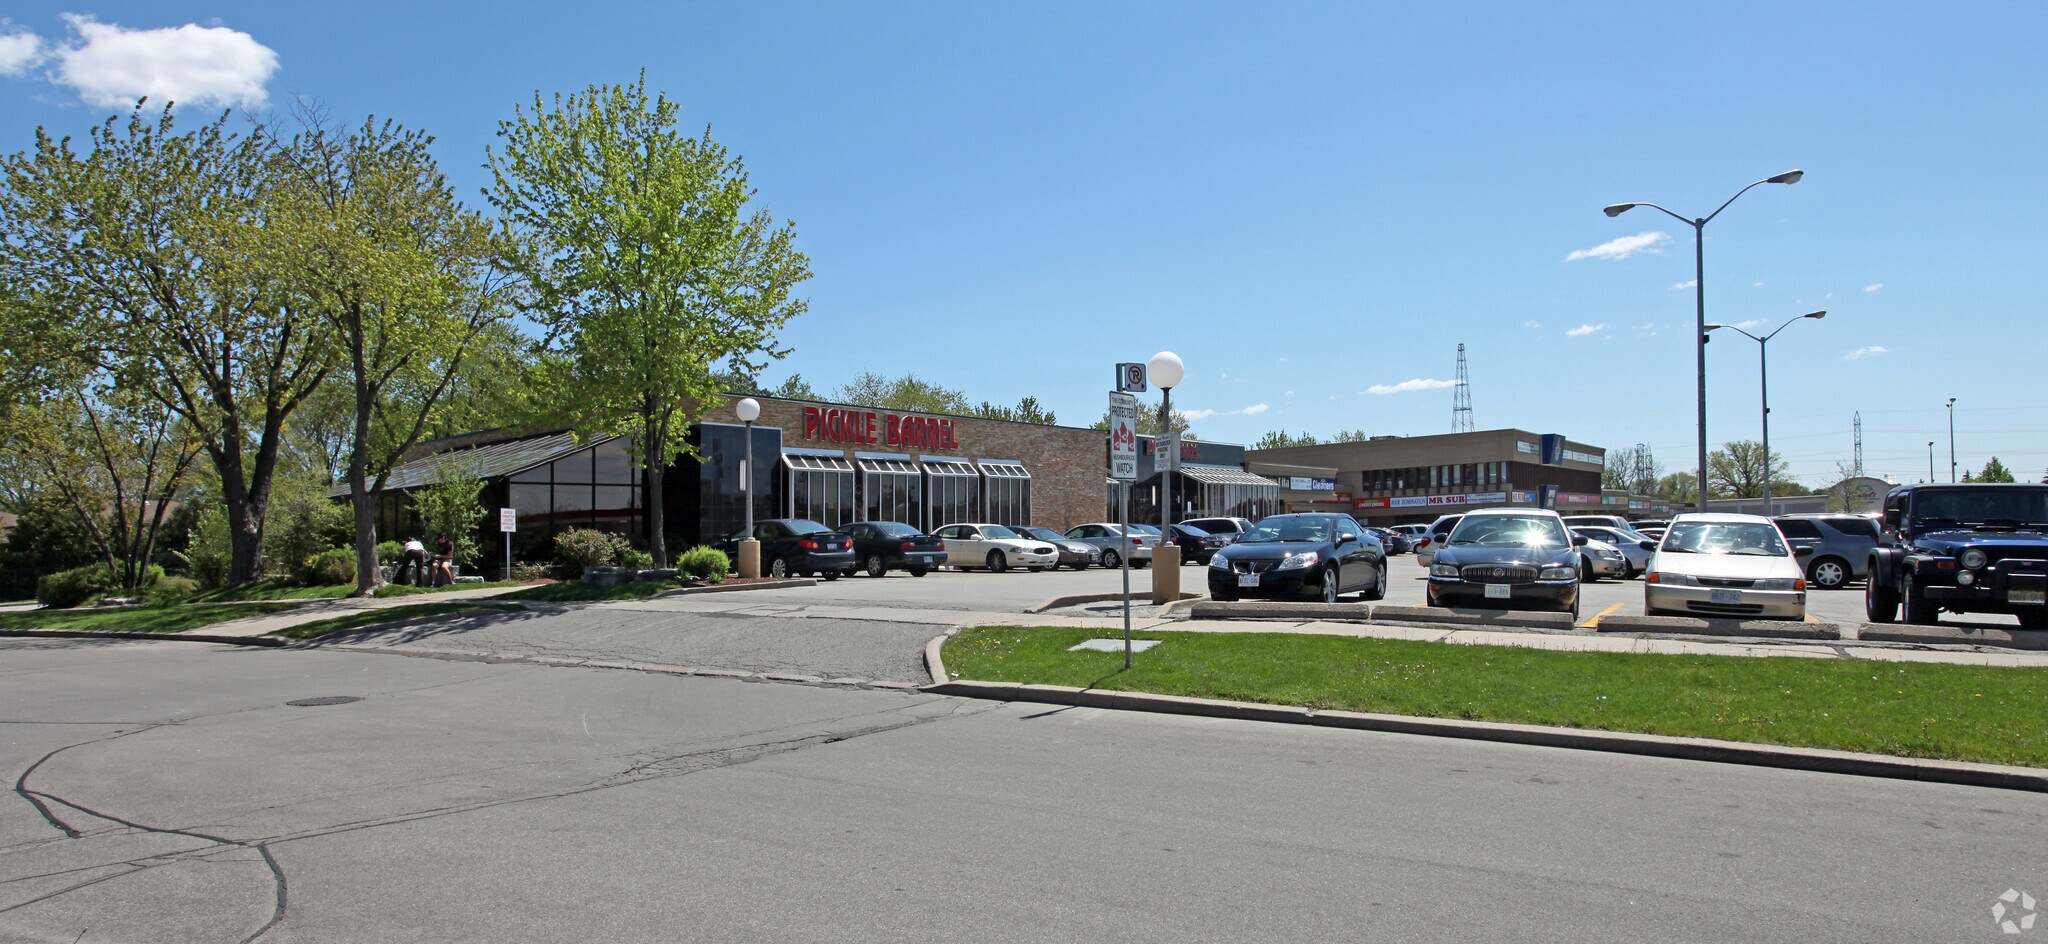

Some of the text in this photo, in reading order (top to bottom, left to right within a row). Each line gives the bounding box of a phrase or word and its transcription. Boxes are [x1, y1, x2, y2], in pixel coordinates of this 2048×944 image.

[1111, 405, 1134, 419] PROTECTED
[805, 406, 959, 449] PICKLE BARREL
[1116, 462, 1133, 475] WATCH
[1312, 480, 1335, 490] Cleaners
[1428, 496, 1442, 505] MR
[1446, 495, 1465, 504] SUB
